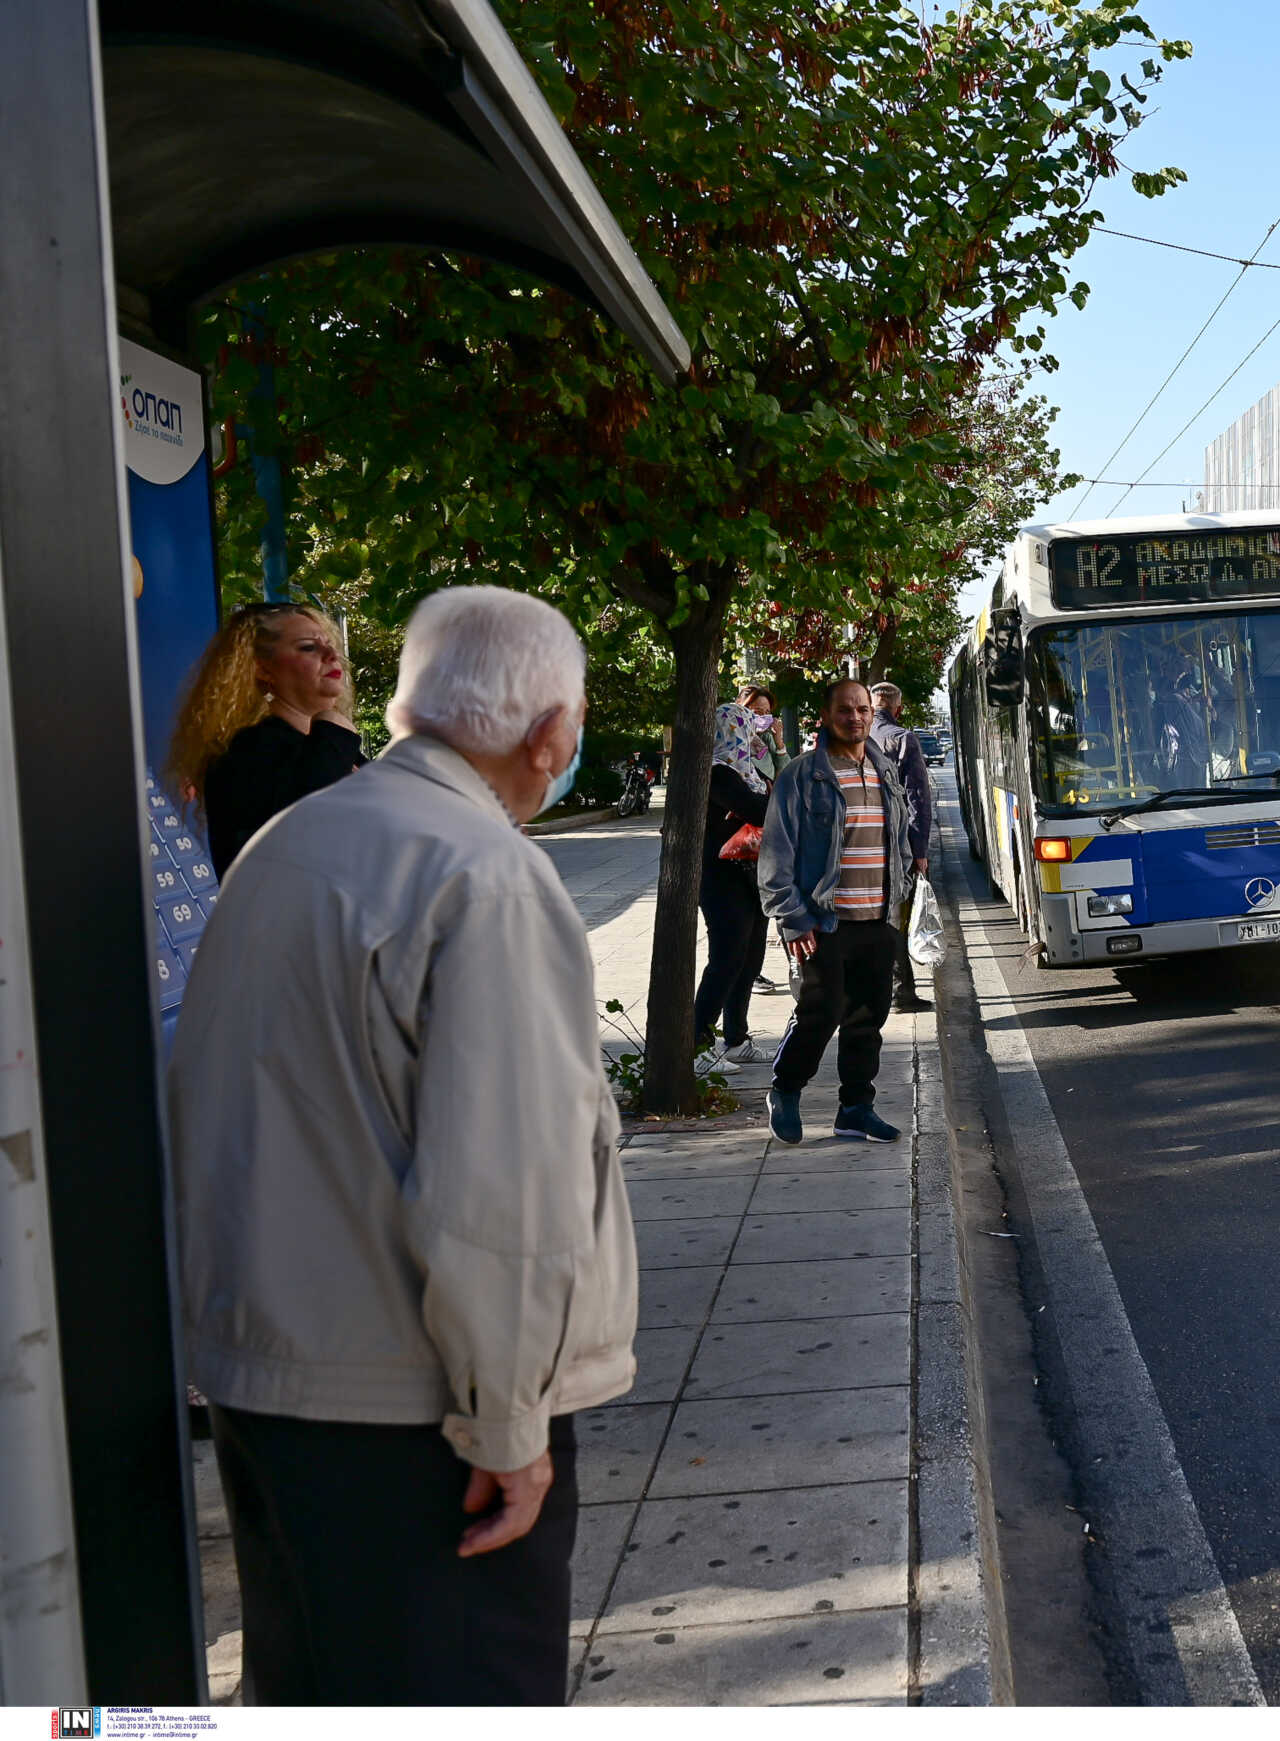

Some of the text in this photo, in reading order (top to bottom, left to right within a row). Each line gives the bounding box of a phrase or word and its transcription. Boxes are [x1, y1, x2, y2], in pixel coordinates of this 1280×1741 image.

[175, 837, 192, 850] 50
[192, 863, 210, 878] 60
[156, 871, 175, 887] 59
[172, 903, 192, 922] 69
